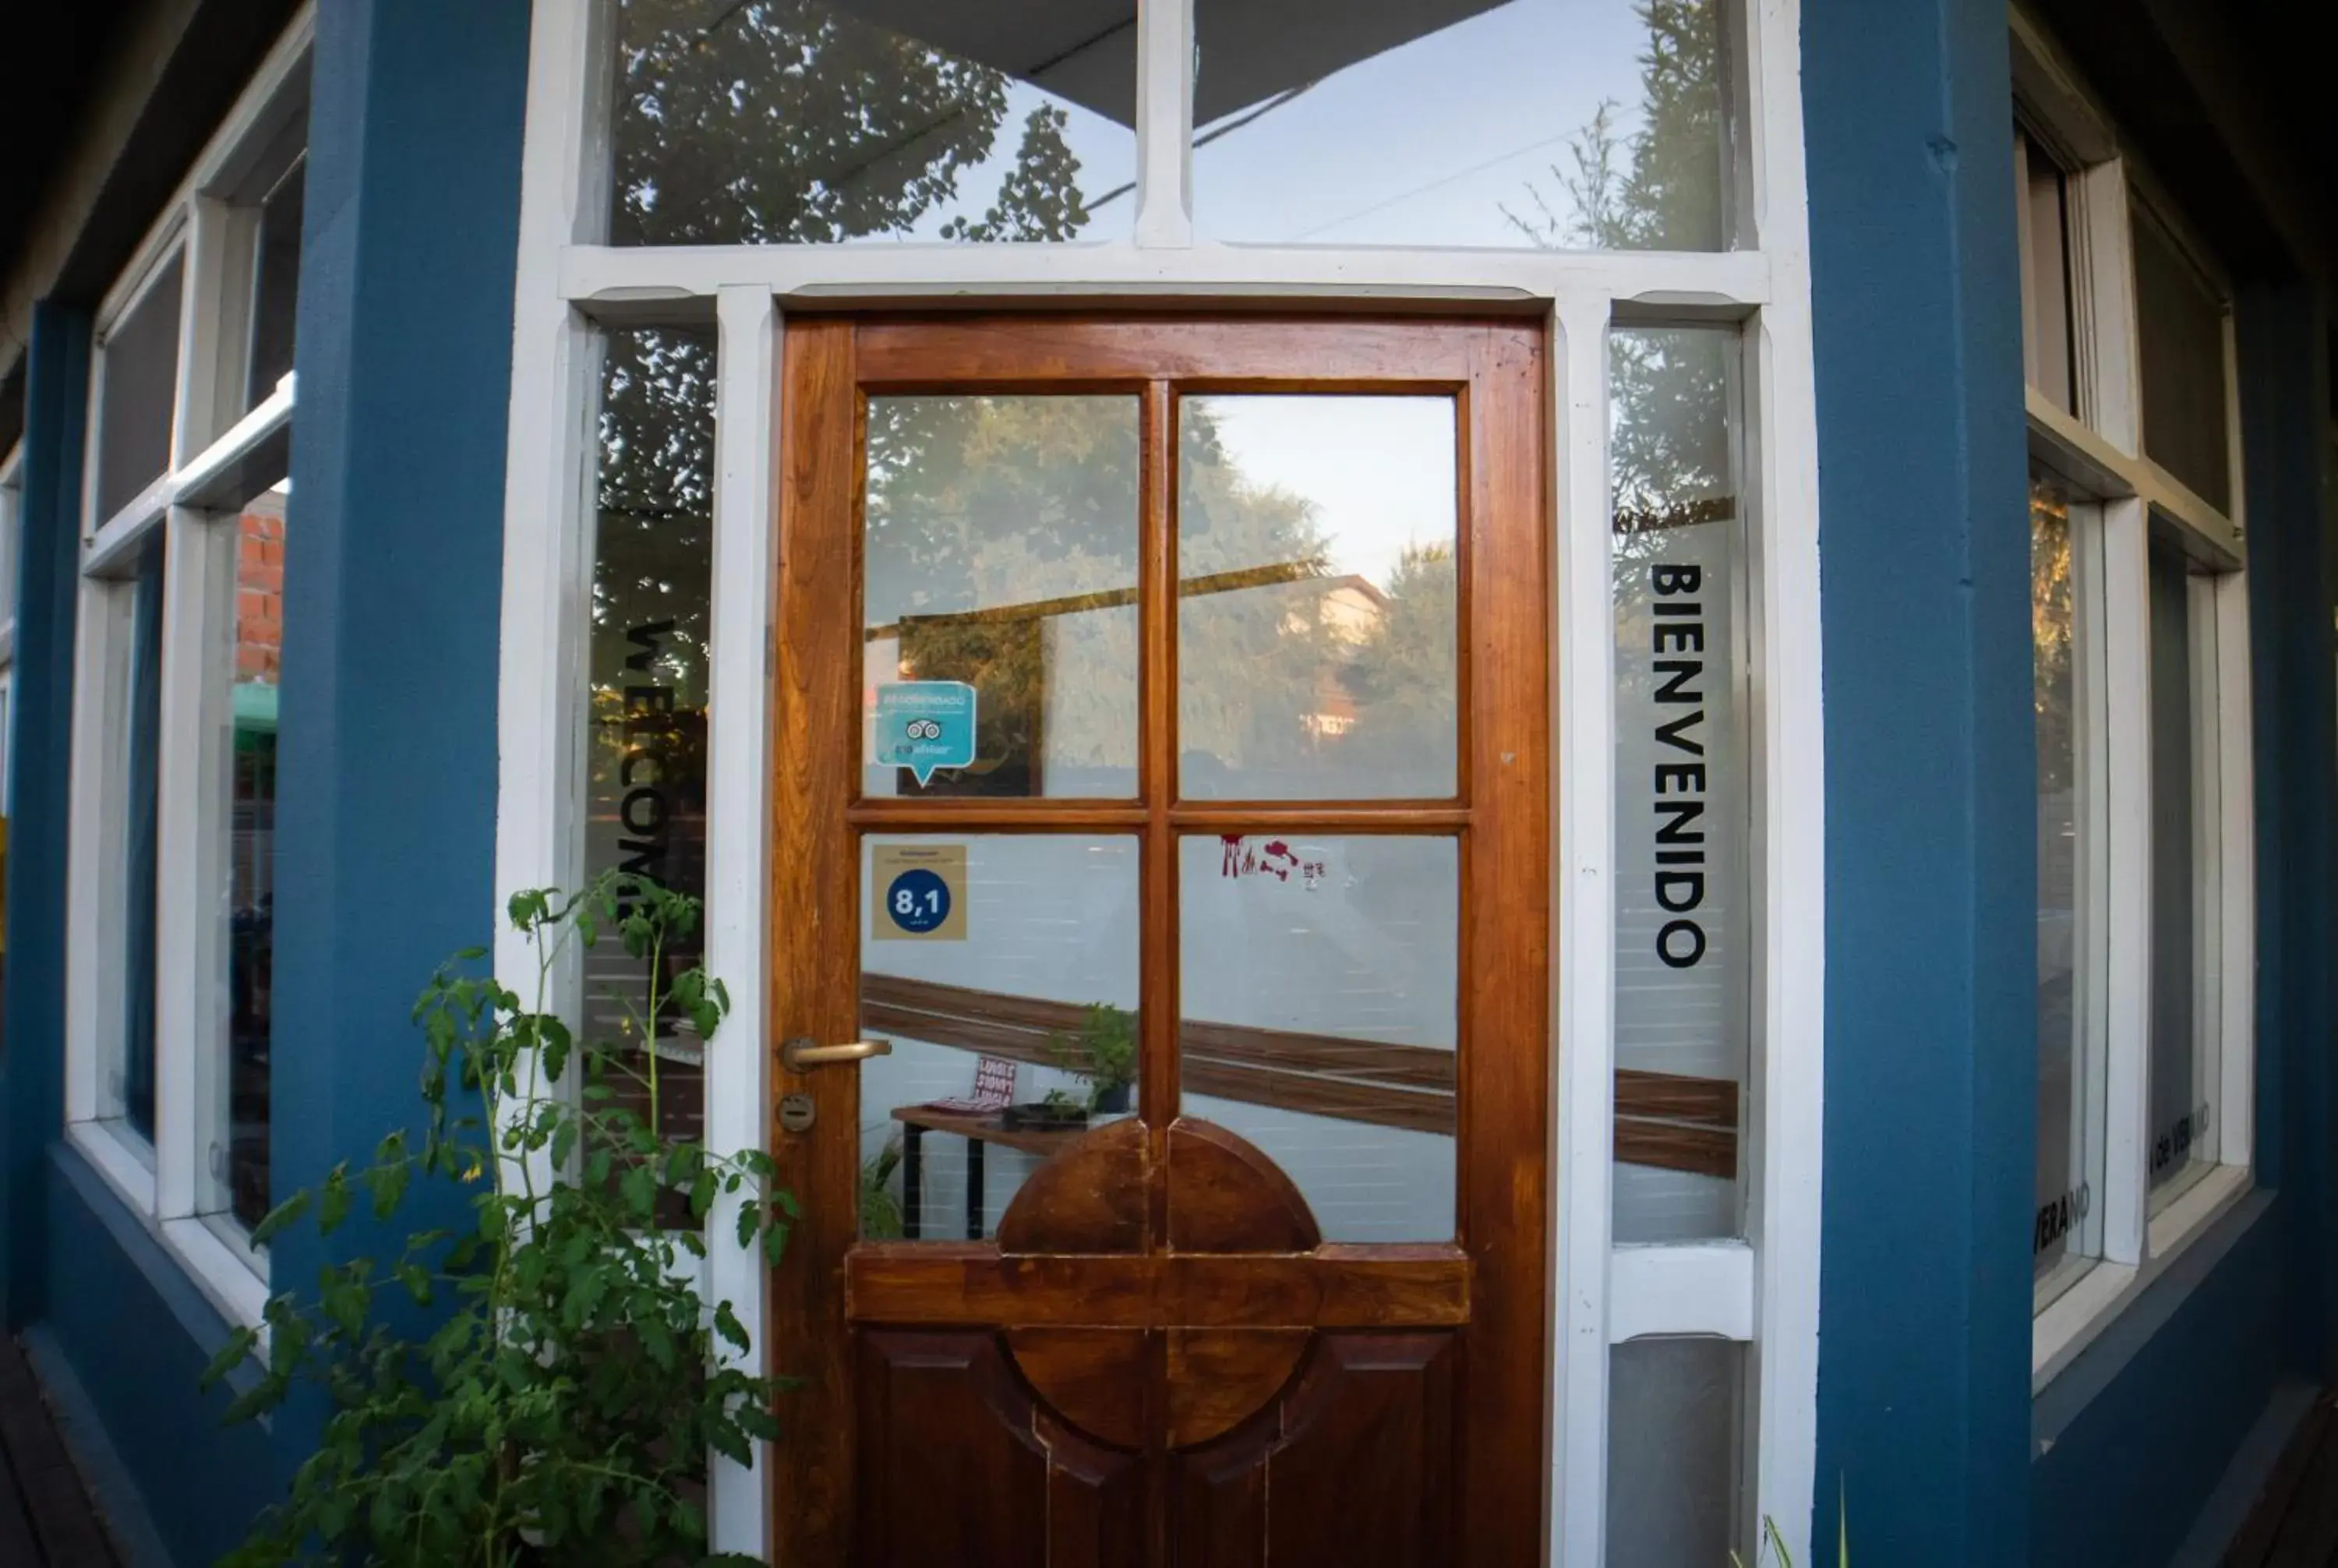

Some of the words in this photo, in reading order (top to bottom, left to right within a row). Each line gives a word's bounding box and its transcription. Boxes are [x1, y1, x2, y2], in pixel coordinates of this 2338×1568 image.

[616, 620, 674, 925] WELCOM
[895, 889, 938, 917] 8,1
[1652, 564, 1705, 968] BIENVENIDO
